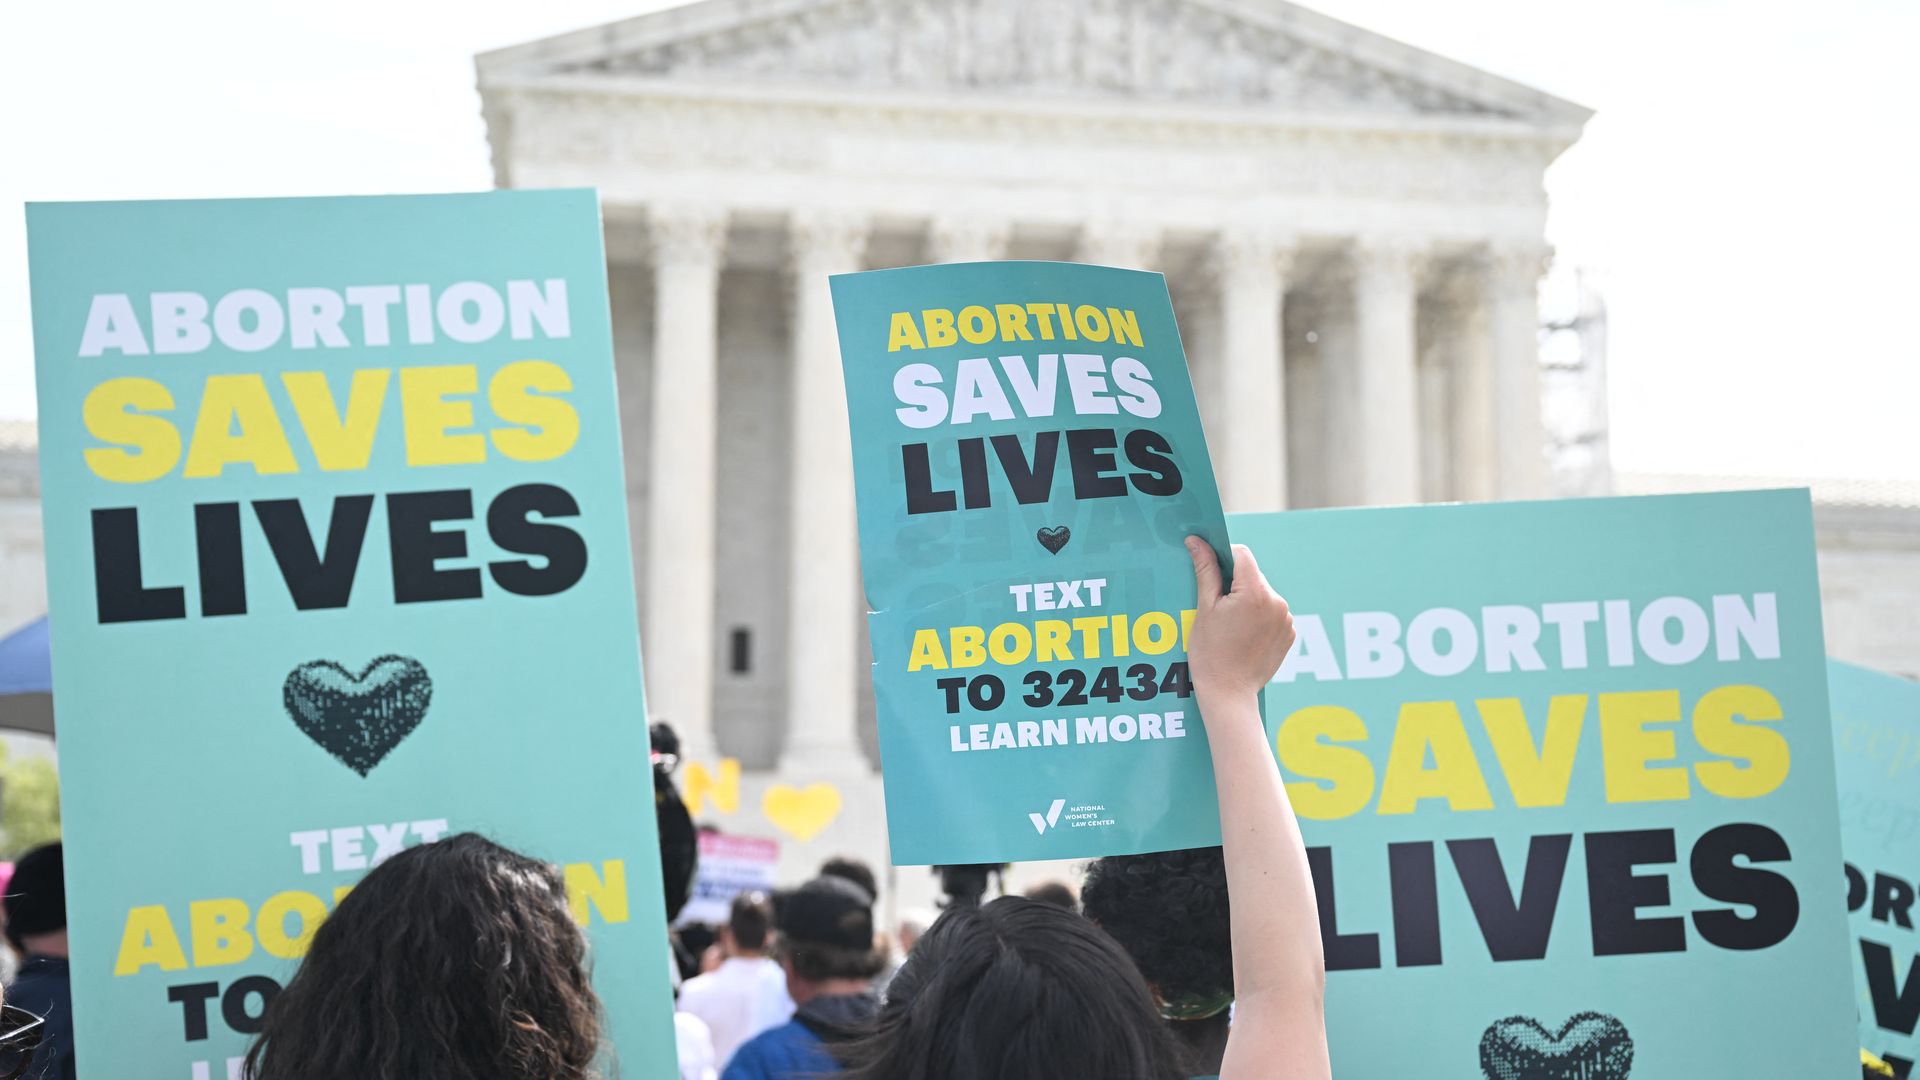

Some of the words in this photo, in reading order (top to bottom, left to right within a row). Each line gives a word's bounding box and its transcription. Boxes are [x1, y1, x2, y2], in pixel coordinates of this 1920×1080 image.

[78, 277, 572, 357] ABORTION
[888, 304, 1145, 353] ABORTION
[82, 359, 580, 483] SAVES
[893, 354, 1162, 428] SAVES
[902, 429, 1183, 515] LIVES
[92, 484, 588, 624] LIVES
[1009, 579, 1107, 612] TEXT
[1272, 592, 1781, 684] ABORTION
[937, 675, 1006, 713] TO
[1022, 662, 1194, 708] 32434
[950, 719, 1068, 752] LEARN
[1076, 711, 1186, 743] MORE
[1276, 684, 1791, 821] SAVES
[1087, 819, 1115, 827] CENTER
[1304, 823, 1800, 972] LIVES
[168, 976, 286, 1041] TO
